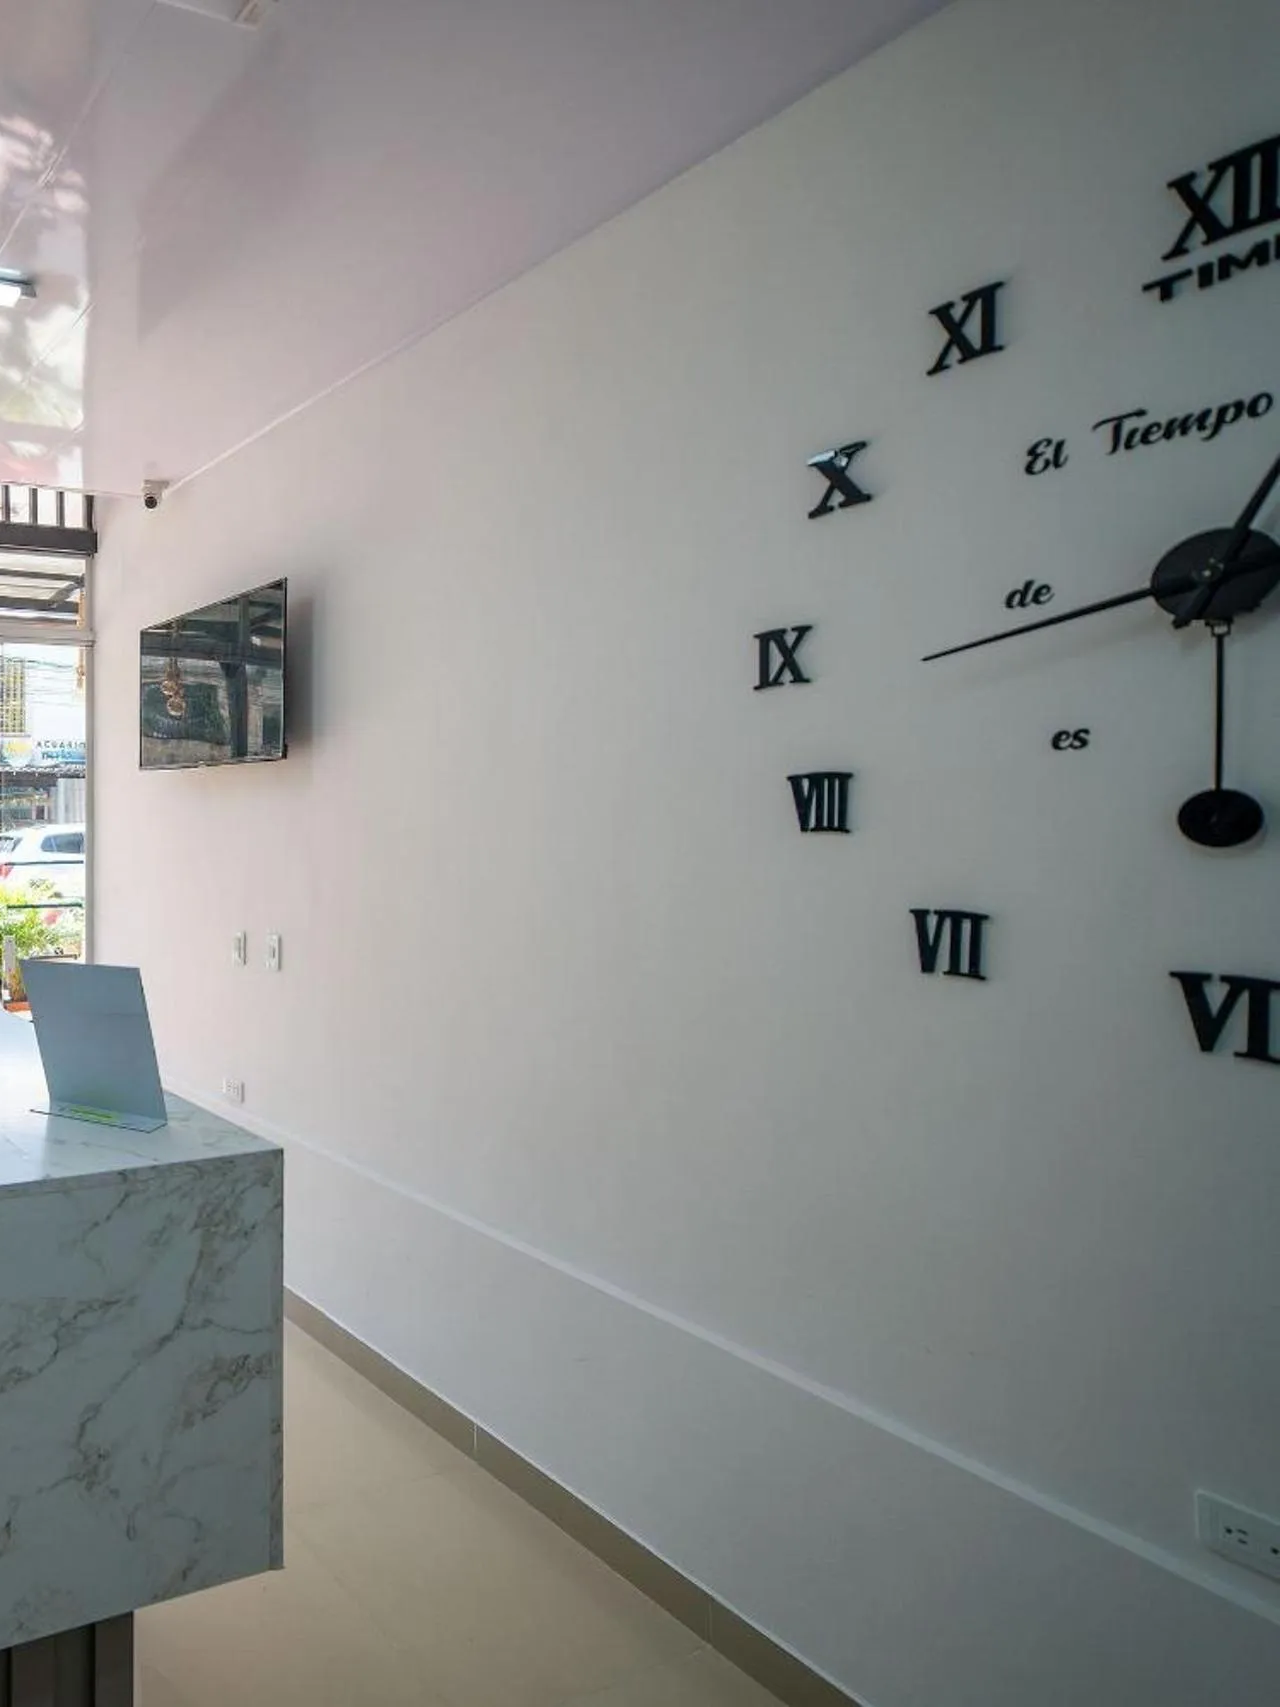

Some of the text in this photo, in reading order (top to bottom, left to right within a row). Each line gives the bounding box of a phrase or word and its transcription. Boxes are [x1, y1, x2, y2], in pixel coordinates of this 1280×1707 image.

[1160, 133, 1280, 262] XII
[1141, 233, 1280, 302] TIM
[926, 280, 1007, 377] XI
[1024, 391, 1273, 476] El Tiempo
[807, 440, 874, 519] X
[1004, 579, 1054, 609] de
[753, 625, 814, 691] IX
[1051, 728, 1091, 751] es
[786, 771, 855, 835] VIII
[909, 908, 991, 982] VII
[1168, 970, 1280, 1066] VI
